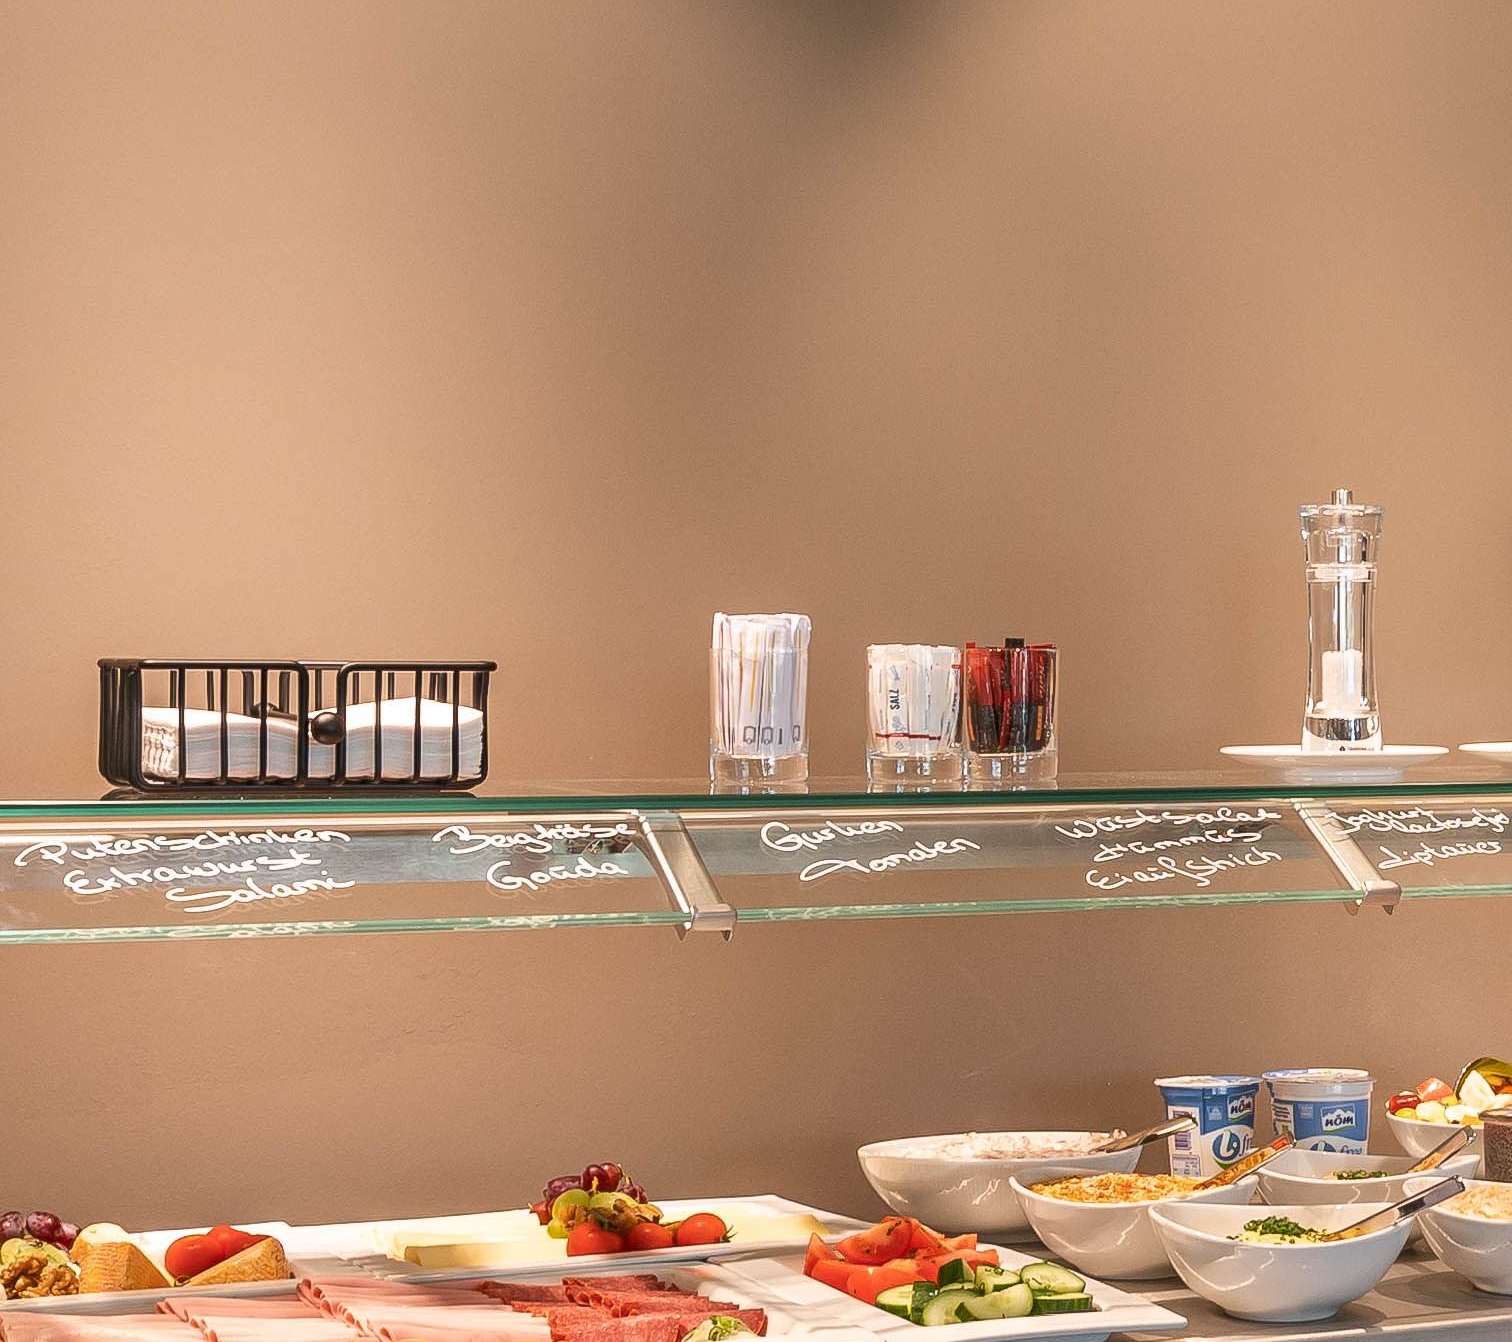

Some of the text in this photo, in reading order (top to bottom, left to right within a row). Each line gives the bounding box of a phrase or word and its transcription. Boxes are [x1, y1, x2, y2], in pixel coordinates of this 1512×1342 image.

[14, 828, 351, 866] Putenschinken
[760, 820, 904, 852] Gurken
[63, 848, 322, 895] Extrawurst
[487, 856, 629, 891] Gouda
[799, 836, 981, 882] Tomaten
[165, 870, 356, 913] Salami
